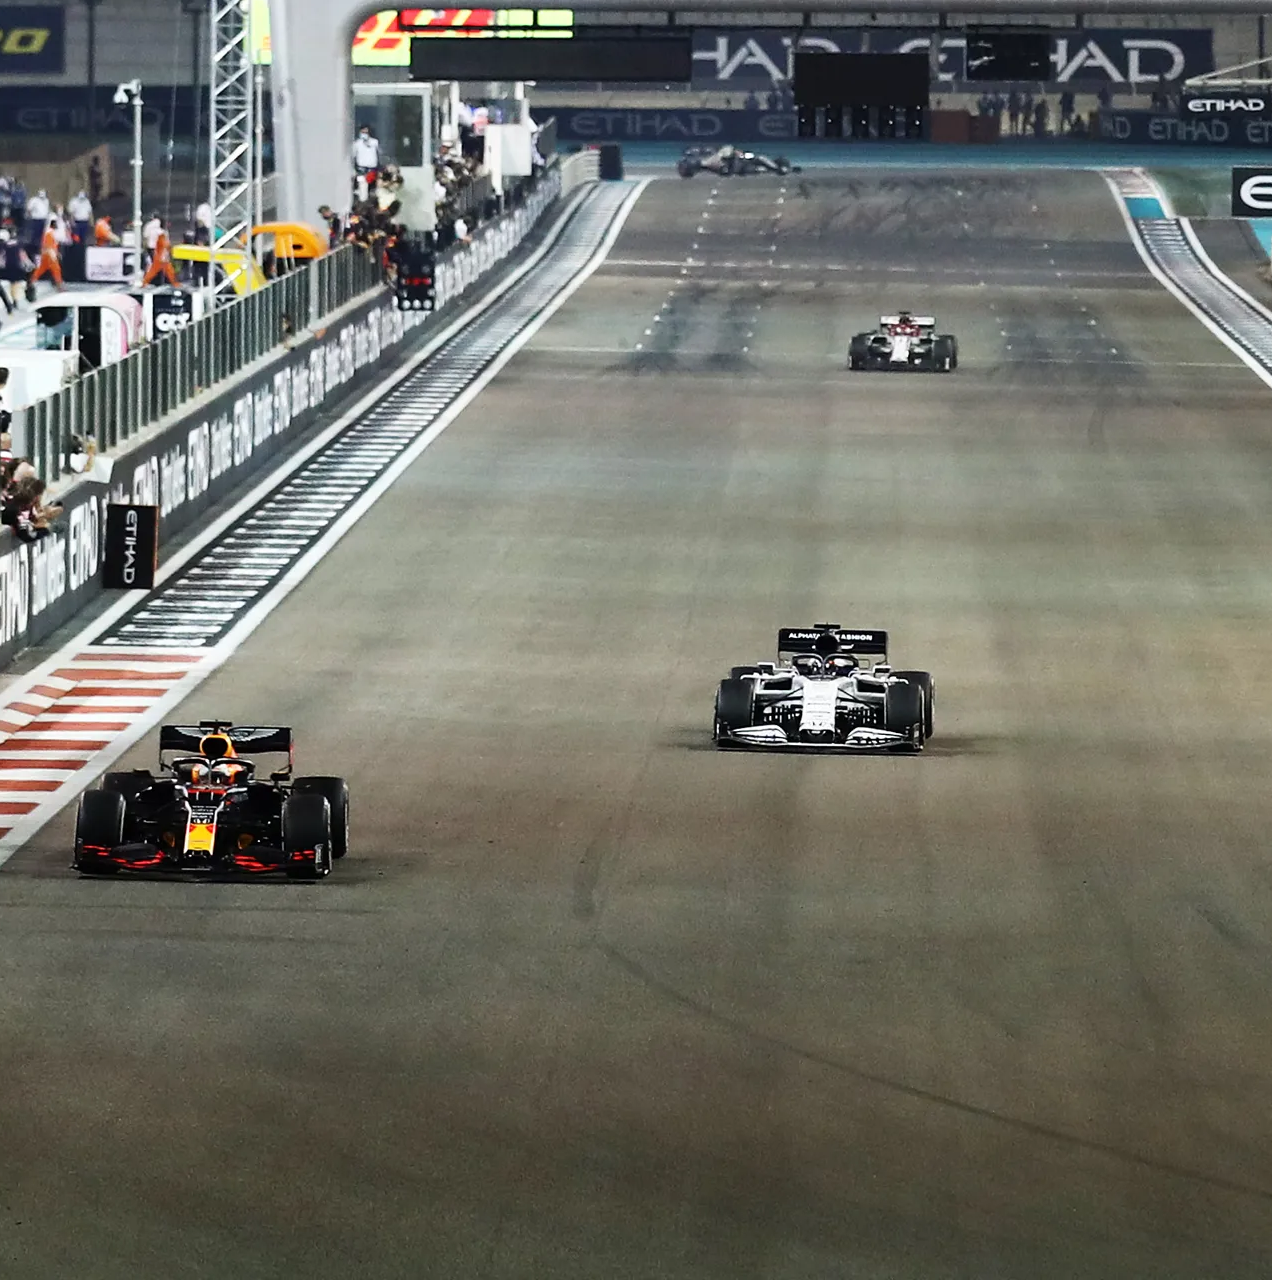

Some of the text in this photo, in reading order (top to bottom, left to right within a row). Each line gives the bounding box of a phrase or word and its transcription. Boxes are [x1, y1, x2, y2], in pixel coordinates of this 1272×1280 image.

[1188, 99, 1265, 113] ETIHAD
[570, 113, 723, 137] ETIHAD
[1148, 118, 1229, 142] ETIHAD
[123, 509, 139, 584] ETIHAD
